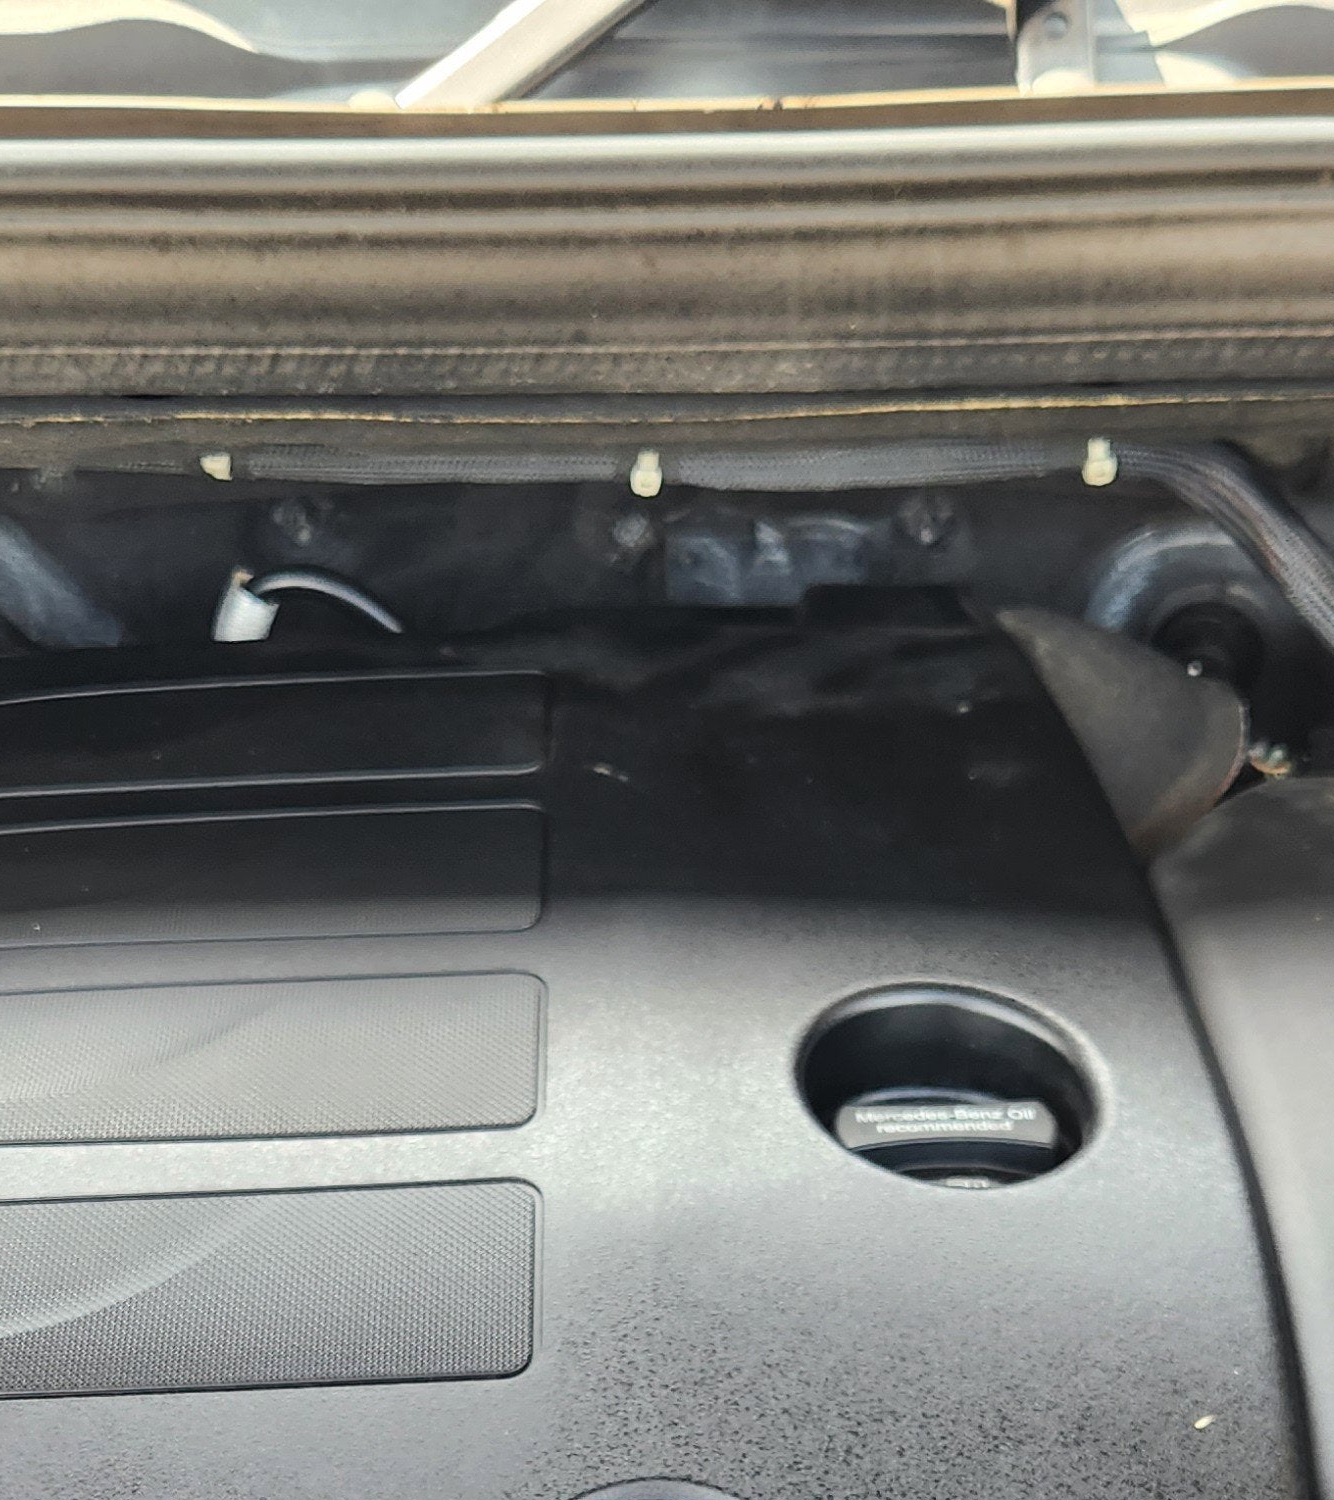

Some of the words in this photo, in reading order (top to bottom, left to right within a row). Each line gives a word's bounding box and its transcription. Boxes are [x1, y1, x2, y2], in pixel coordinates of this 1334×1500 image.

[855, 1107, 1004, 1123] Mercedes-Benz
[1007, 1106, 1037, 1121] Oil
[876, 1121, 1014, 1134] recommended
